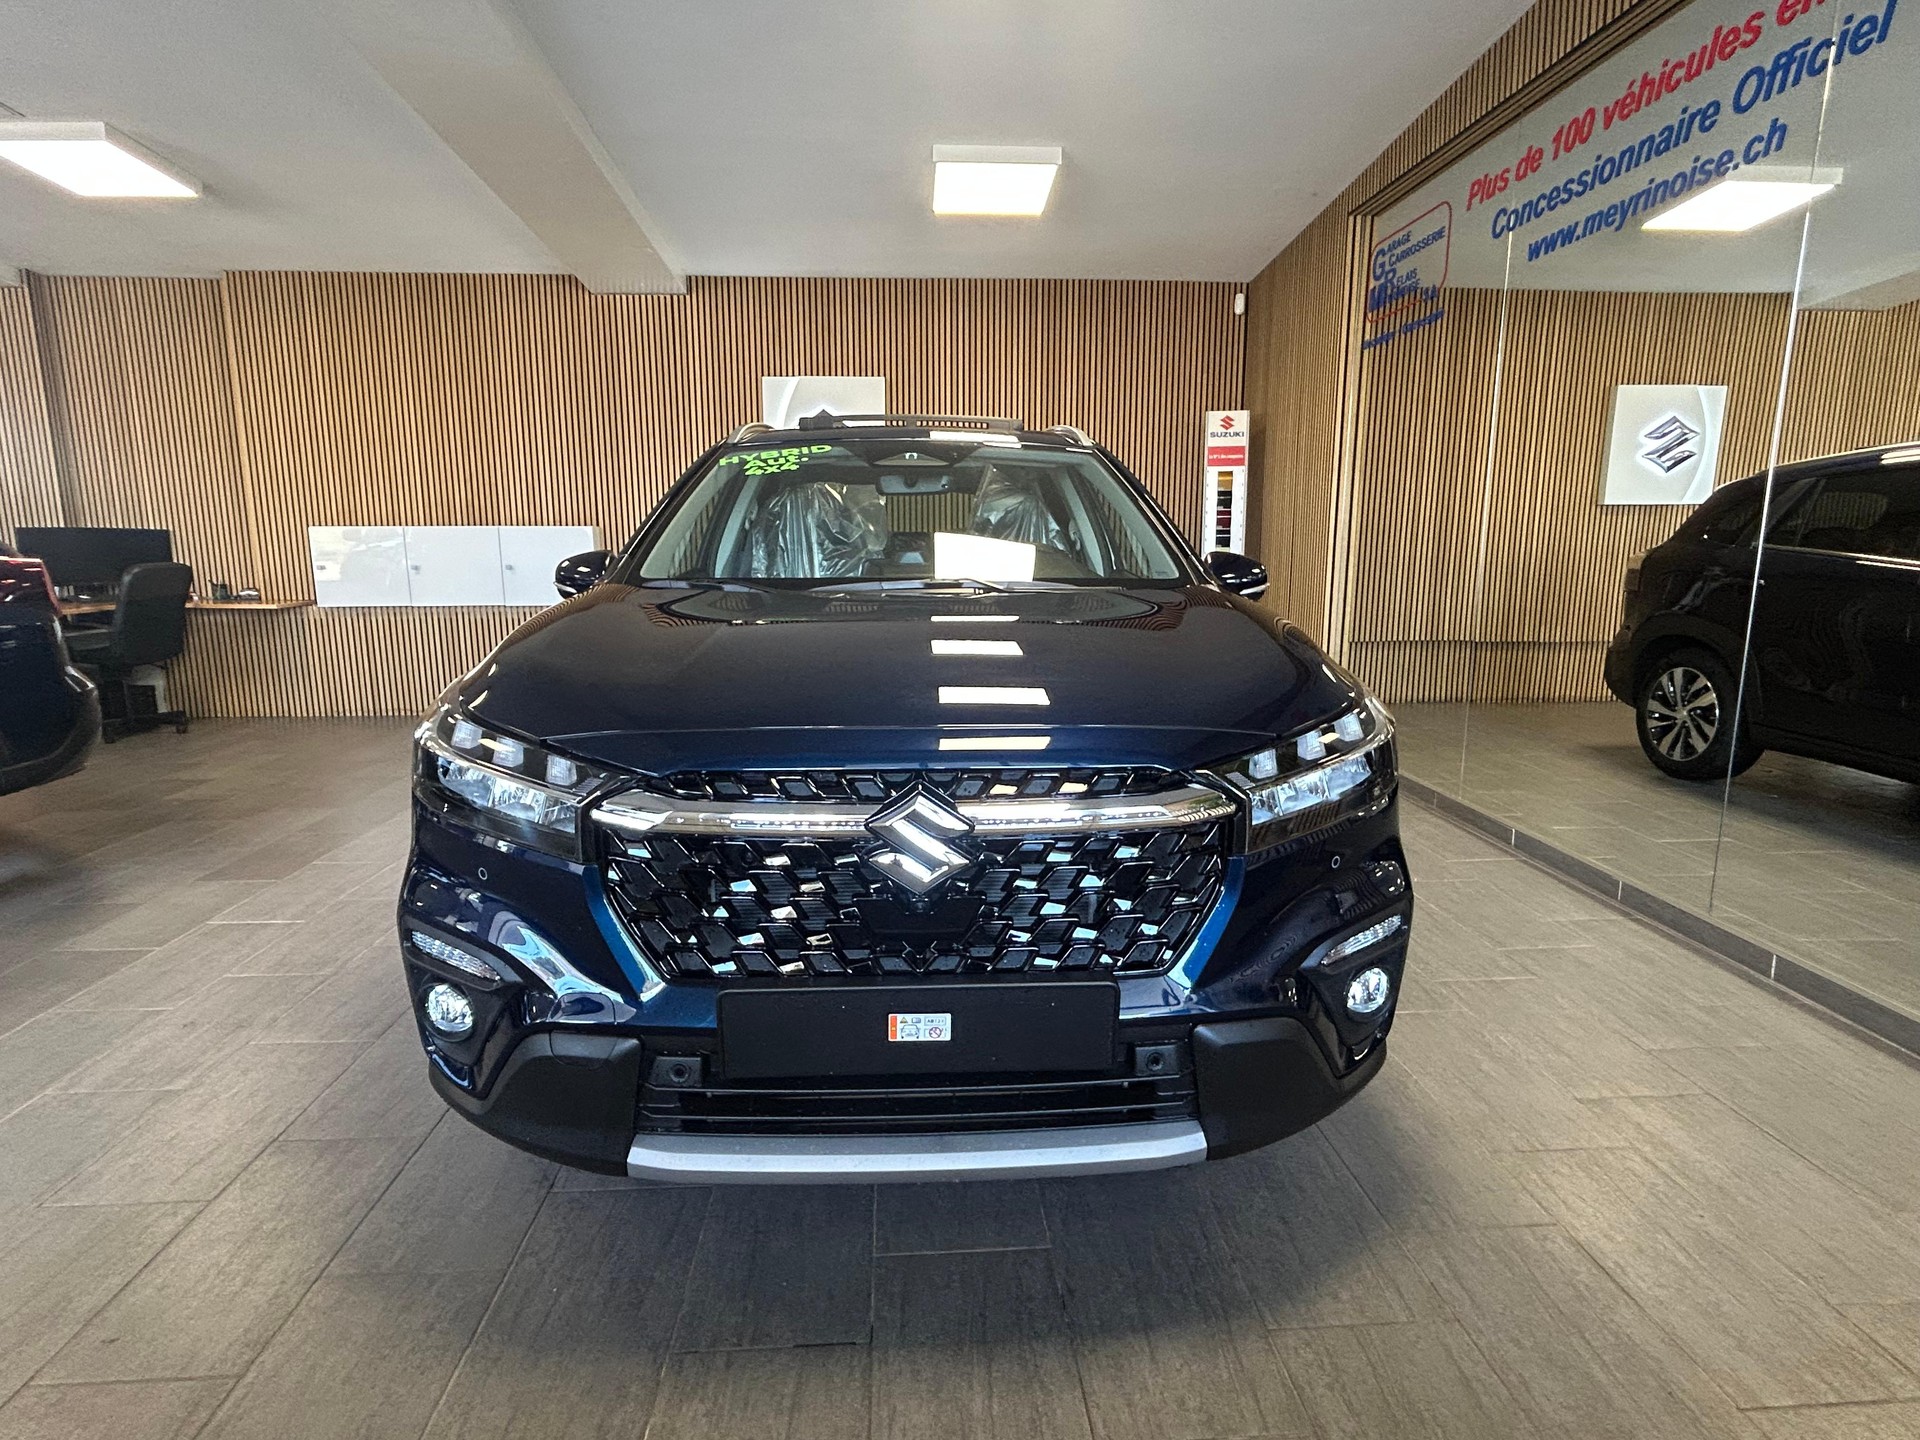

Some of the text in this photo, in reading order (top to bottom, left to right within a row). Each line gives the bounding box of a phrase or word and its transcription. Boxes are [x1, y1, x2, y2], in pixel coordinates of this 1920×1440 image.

[1466, 168, 1511, 211] Plus
[1515, 145, 1544, 182] de
[1552, 107, 1596, 161] 100
[1603, 11, 1766, 130] véhicules
[1491, 0, 1898, 239] Concessionnaire Officiel
[1527, 117, 1788, 262] www.meyrinoise.ch
[1389, 226, 1446, 266] CARROSSERIE
[719, 444, 832, 466] HYBRID
[743, 455, 809, 469] Aut.
[745, 461, 800, 475] 4x4
